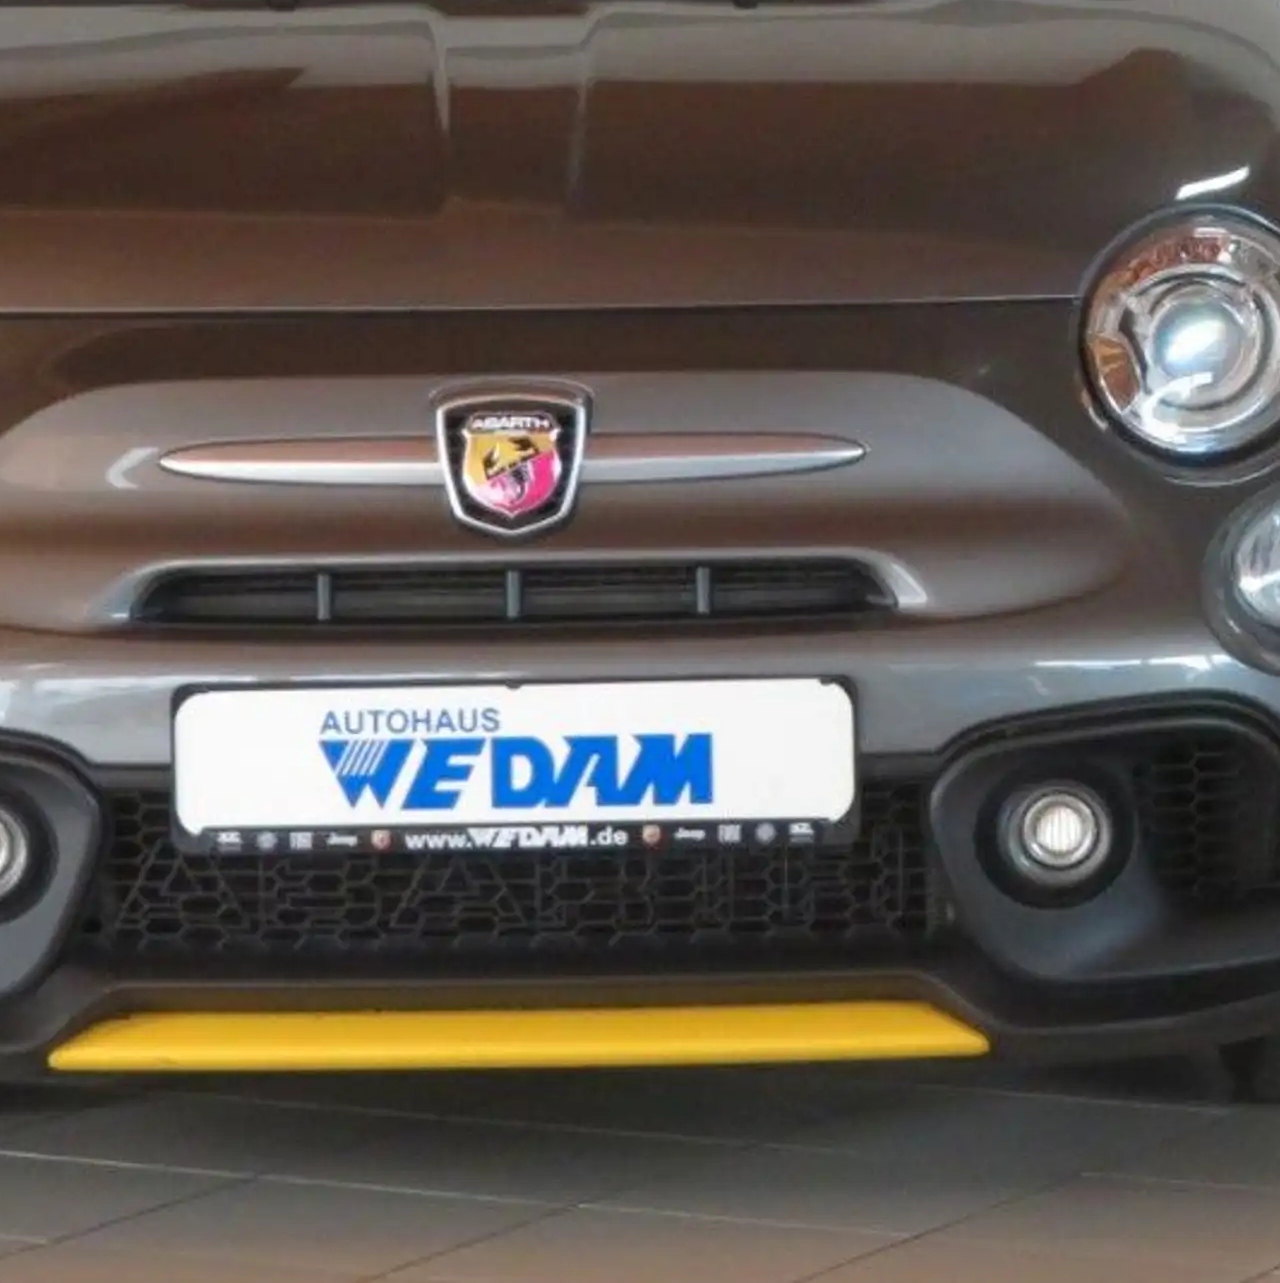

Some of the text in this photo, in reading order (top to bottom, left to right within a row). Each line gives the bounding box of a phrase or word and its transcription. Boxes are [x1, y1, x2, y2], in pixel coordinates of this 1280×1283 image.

[470, 416, 551, 429] ABARTH
[320, 707, 501, 734] AUTOHAUS
[319, 732, 713, 810] WEDAM
